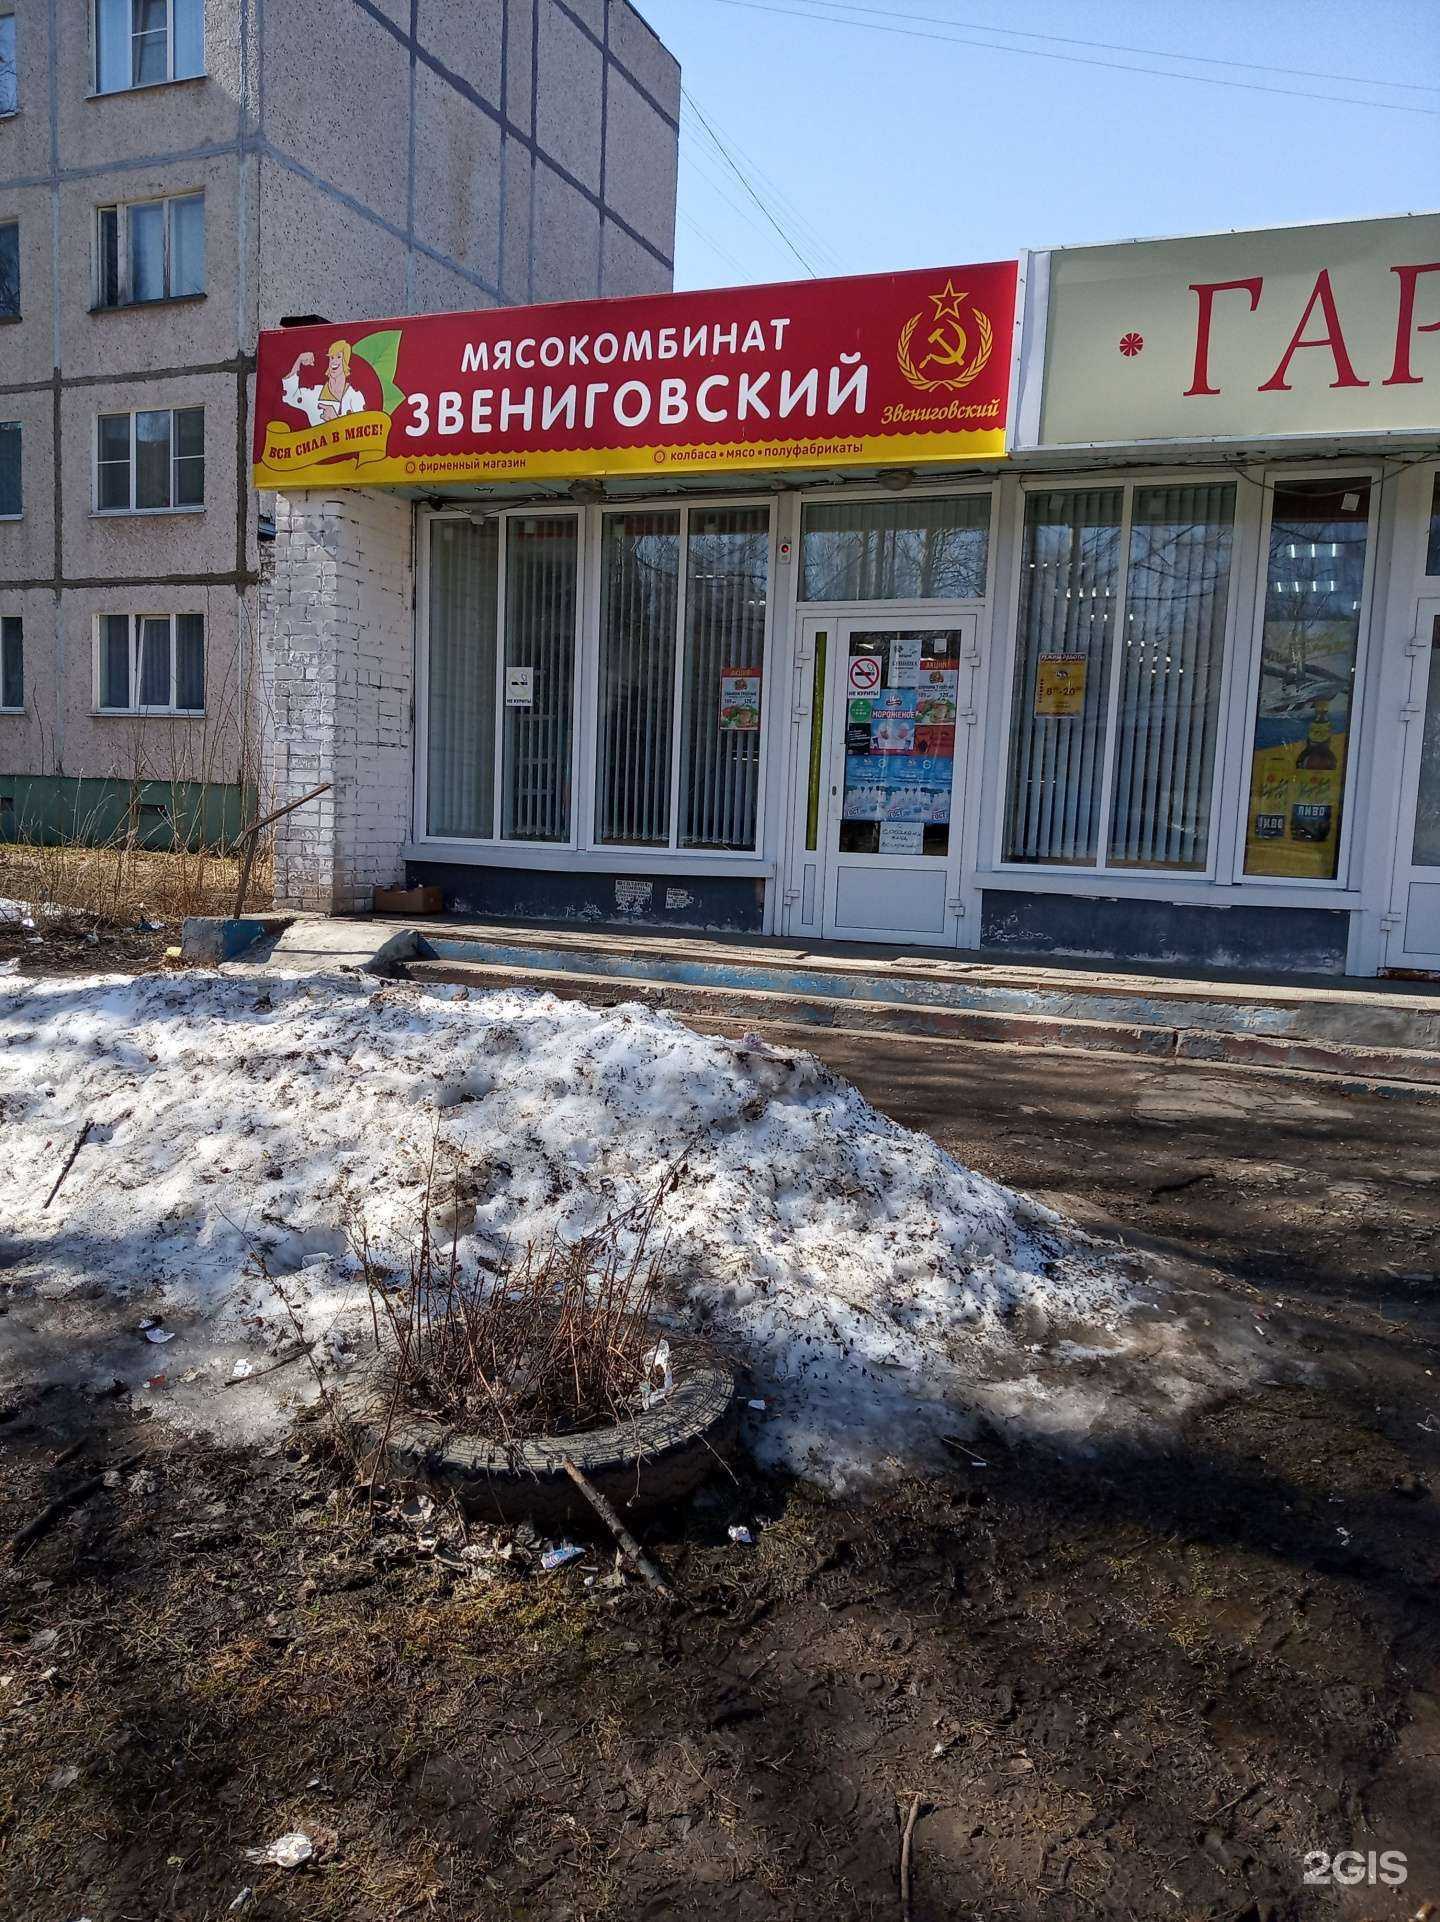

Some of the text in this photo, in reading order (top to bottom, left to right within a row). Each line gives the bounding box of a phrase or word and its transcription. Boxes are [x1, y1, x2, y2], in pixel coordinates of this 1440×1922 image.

[460, 317, 791, 373] МЯСОКОМБИНАТ
[405, 351, 869, 437] ЗВЕНИГОВСКИЙ
[880, 398, 1001, 425] Звениговский
[269, 423, 383, 460] ВСЯ СИЛА В МЯСЕ!
[670, 442, 863, 461] колбаса мясо полуфабрикаты
[418, 458, 526, 474] фирменный магазин
[872, 709, 916, 719] МОРОЖЕНОЕ
[1297, 804, 1326, 817] ПИВО
